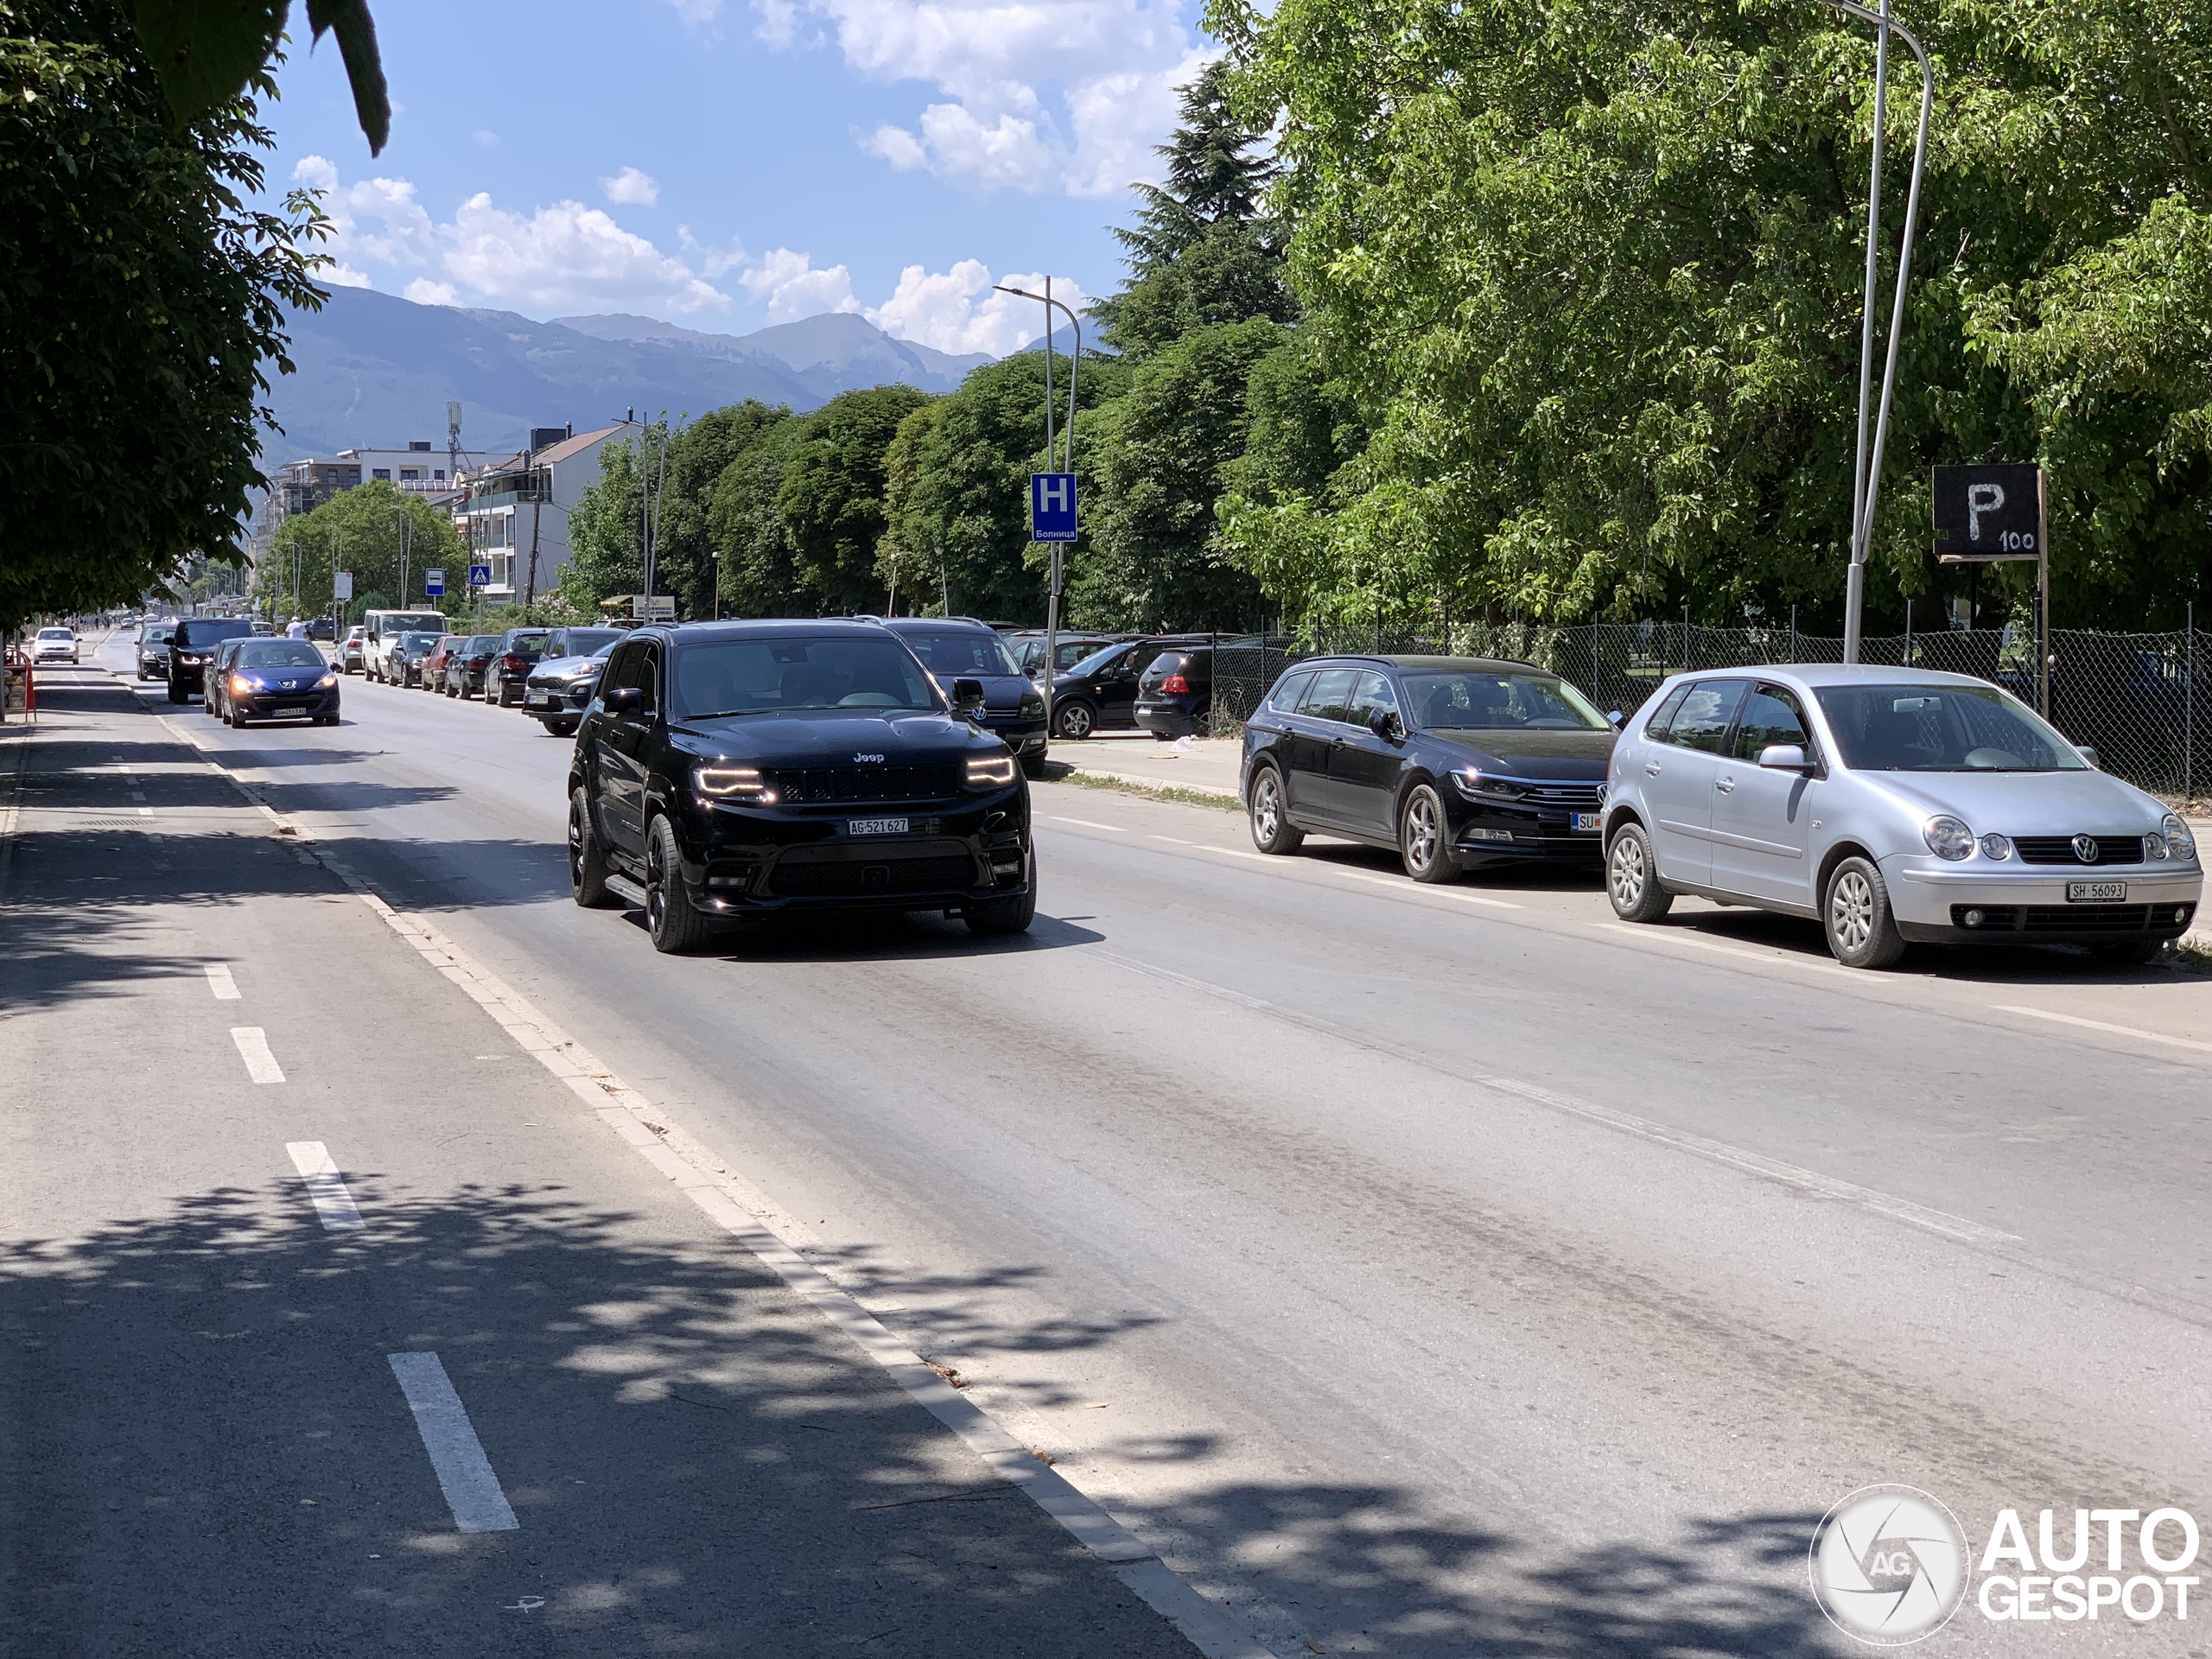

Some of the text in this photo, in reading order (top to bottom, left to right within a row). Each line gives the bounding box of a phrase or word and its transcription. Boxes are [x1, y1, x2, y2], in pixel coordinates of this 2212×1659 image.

[1040, 478, 1067, 512] H
[1968, 484, 2004, 541] P
[1036, 530, 1075, 538] Болница
[1999, 531, 2034, 552] 100
[853, 753, 885, 763] Jeep
[1580, 816, 1594, 829] SU
